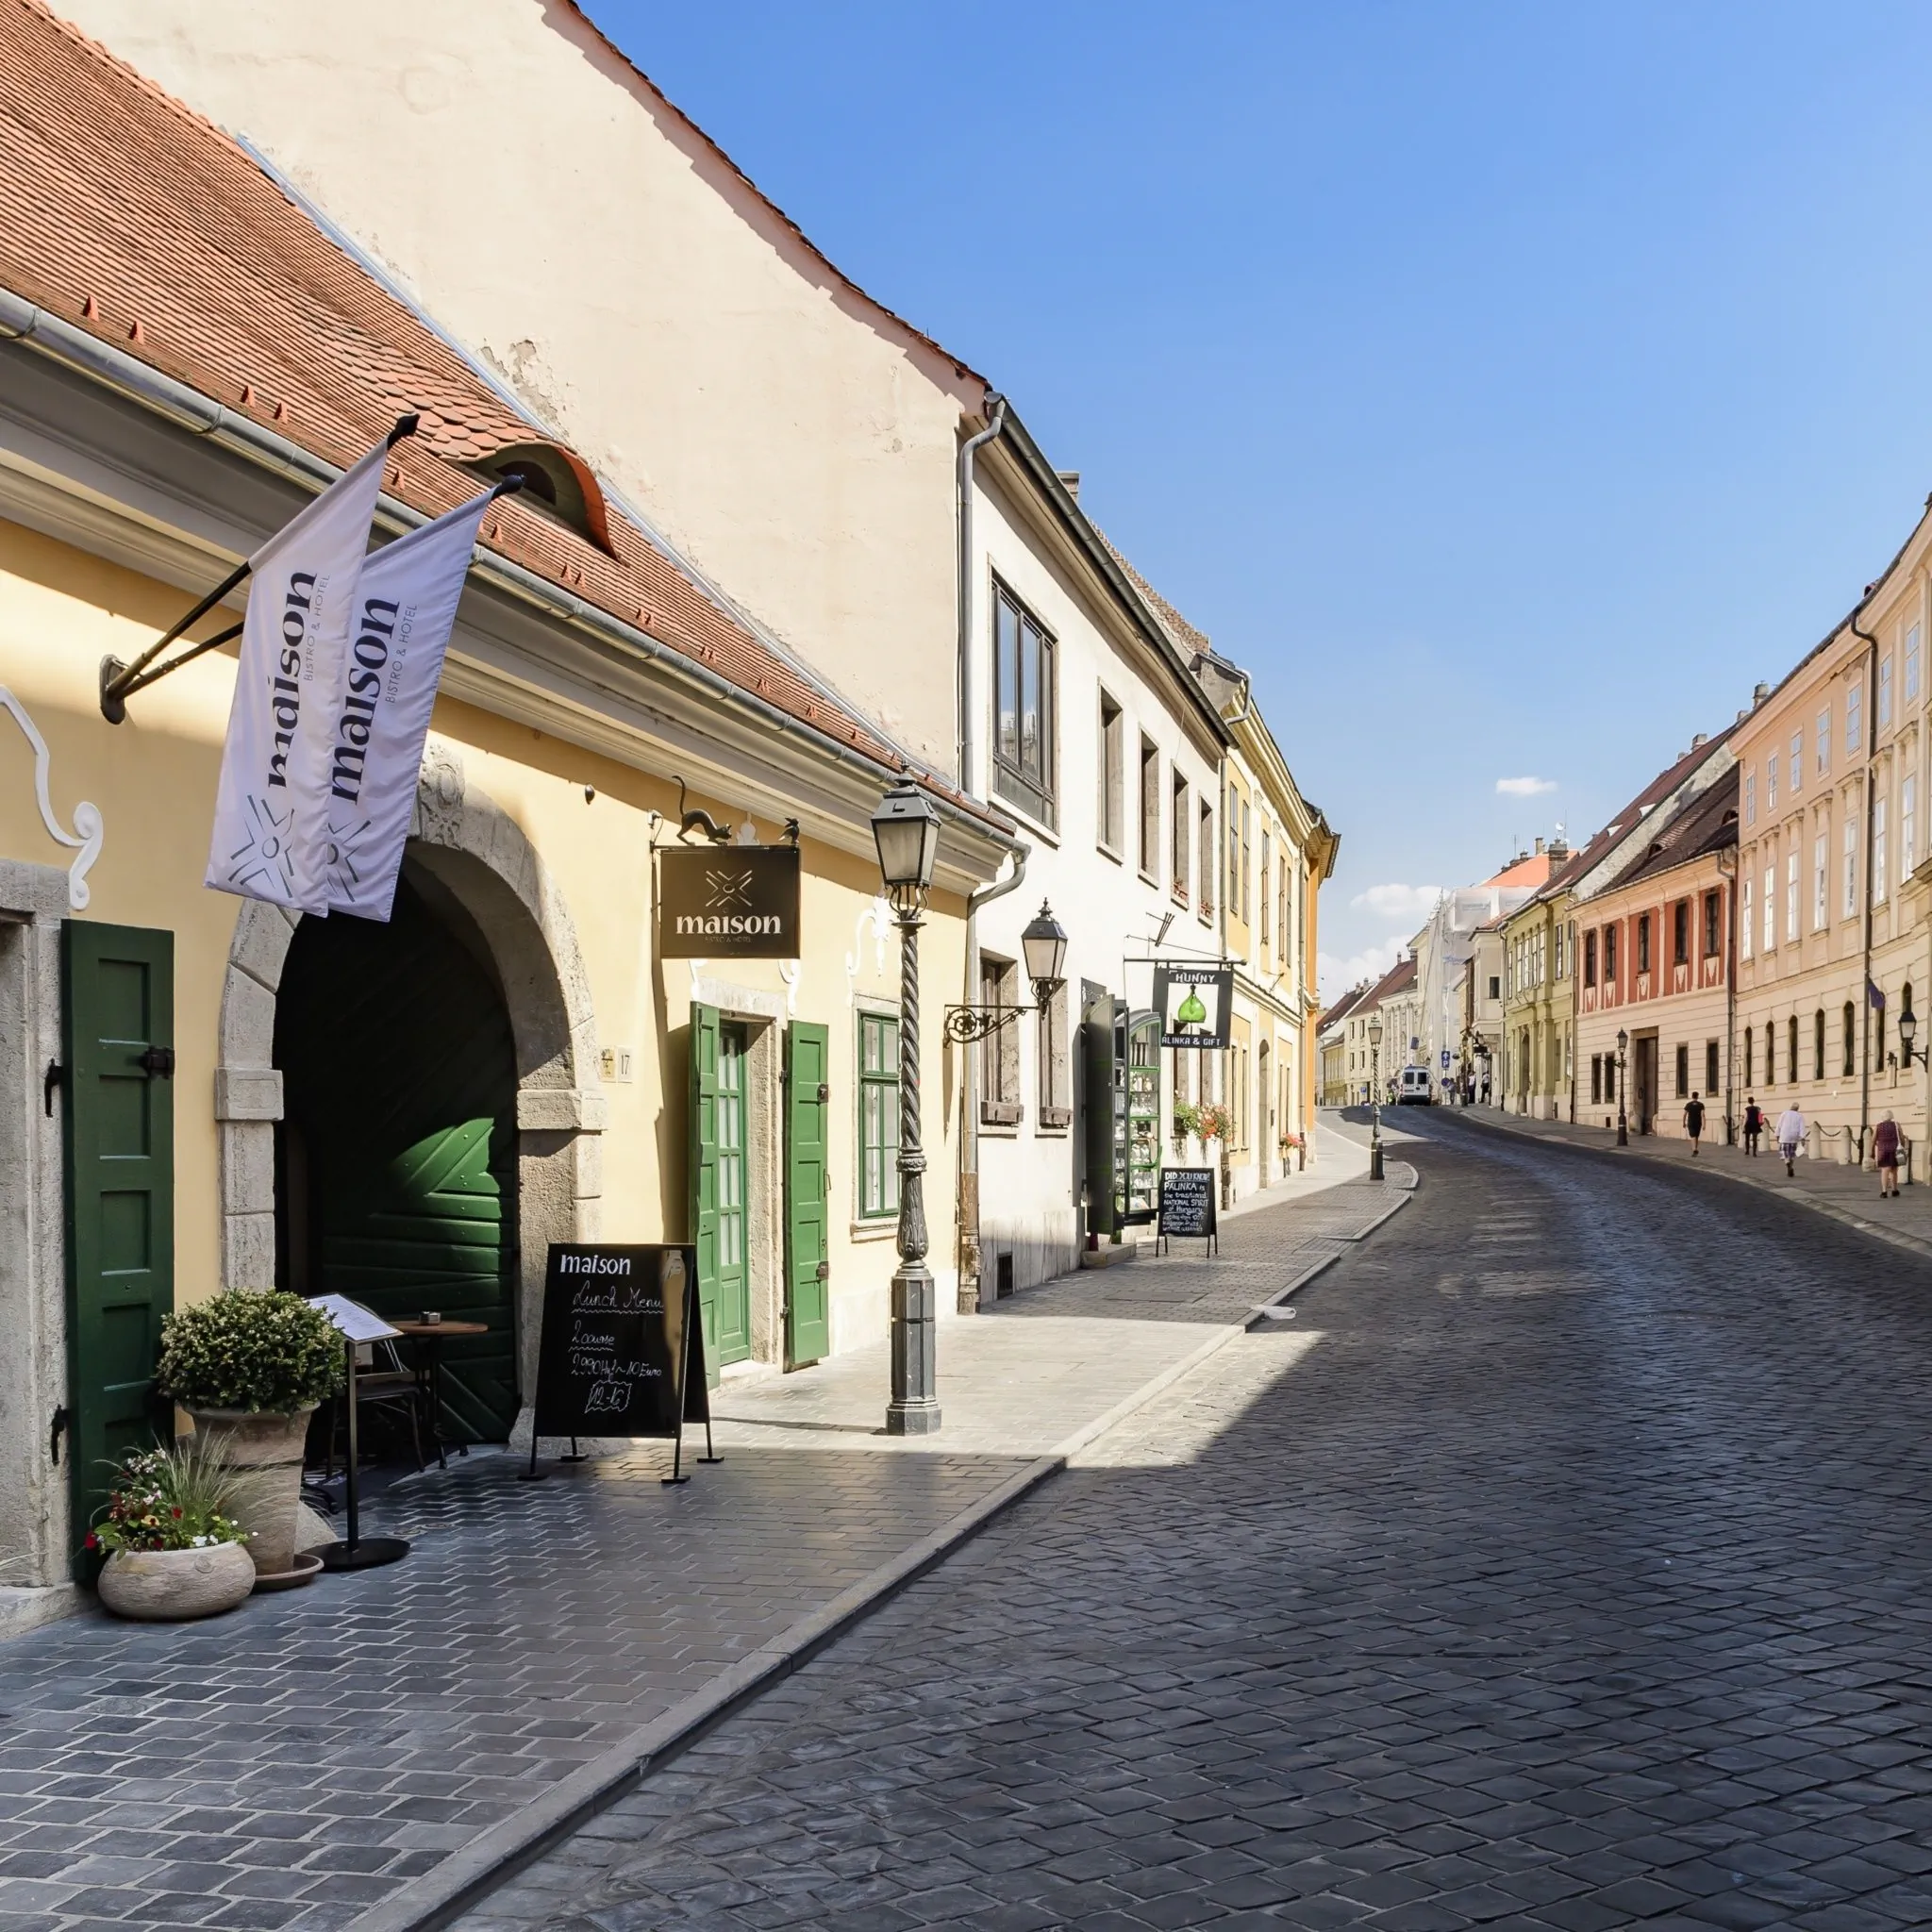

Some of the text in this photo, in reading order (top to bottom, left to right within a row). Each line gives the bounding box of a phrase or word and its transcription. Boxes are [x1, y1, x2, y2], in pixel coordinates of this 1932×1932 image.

[303, 575, 330, 681] BISTRO & HOTEL
[385, 605, 417, 704] BISTRO & HOTEL
[332, 598, 400, 805] maison
[675, 914, 782, 935] maison
[1175, 973, 1215, 984] HUNNY
[1192, 1037, 1201, 1045] &
[1203, 1038, 1221, 1046] GIFT
[621, 1055, 630, 1074] 17
[1164, 1172, 1178, 1180] DID
[559, 1254, 631, 1274] maison
[573, 1280, 664, 1308] Lunch Menu
[572, 1320, 581, 1343] 2
